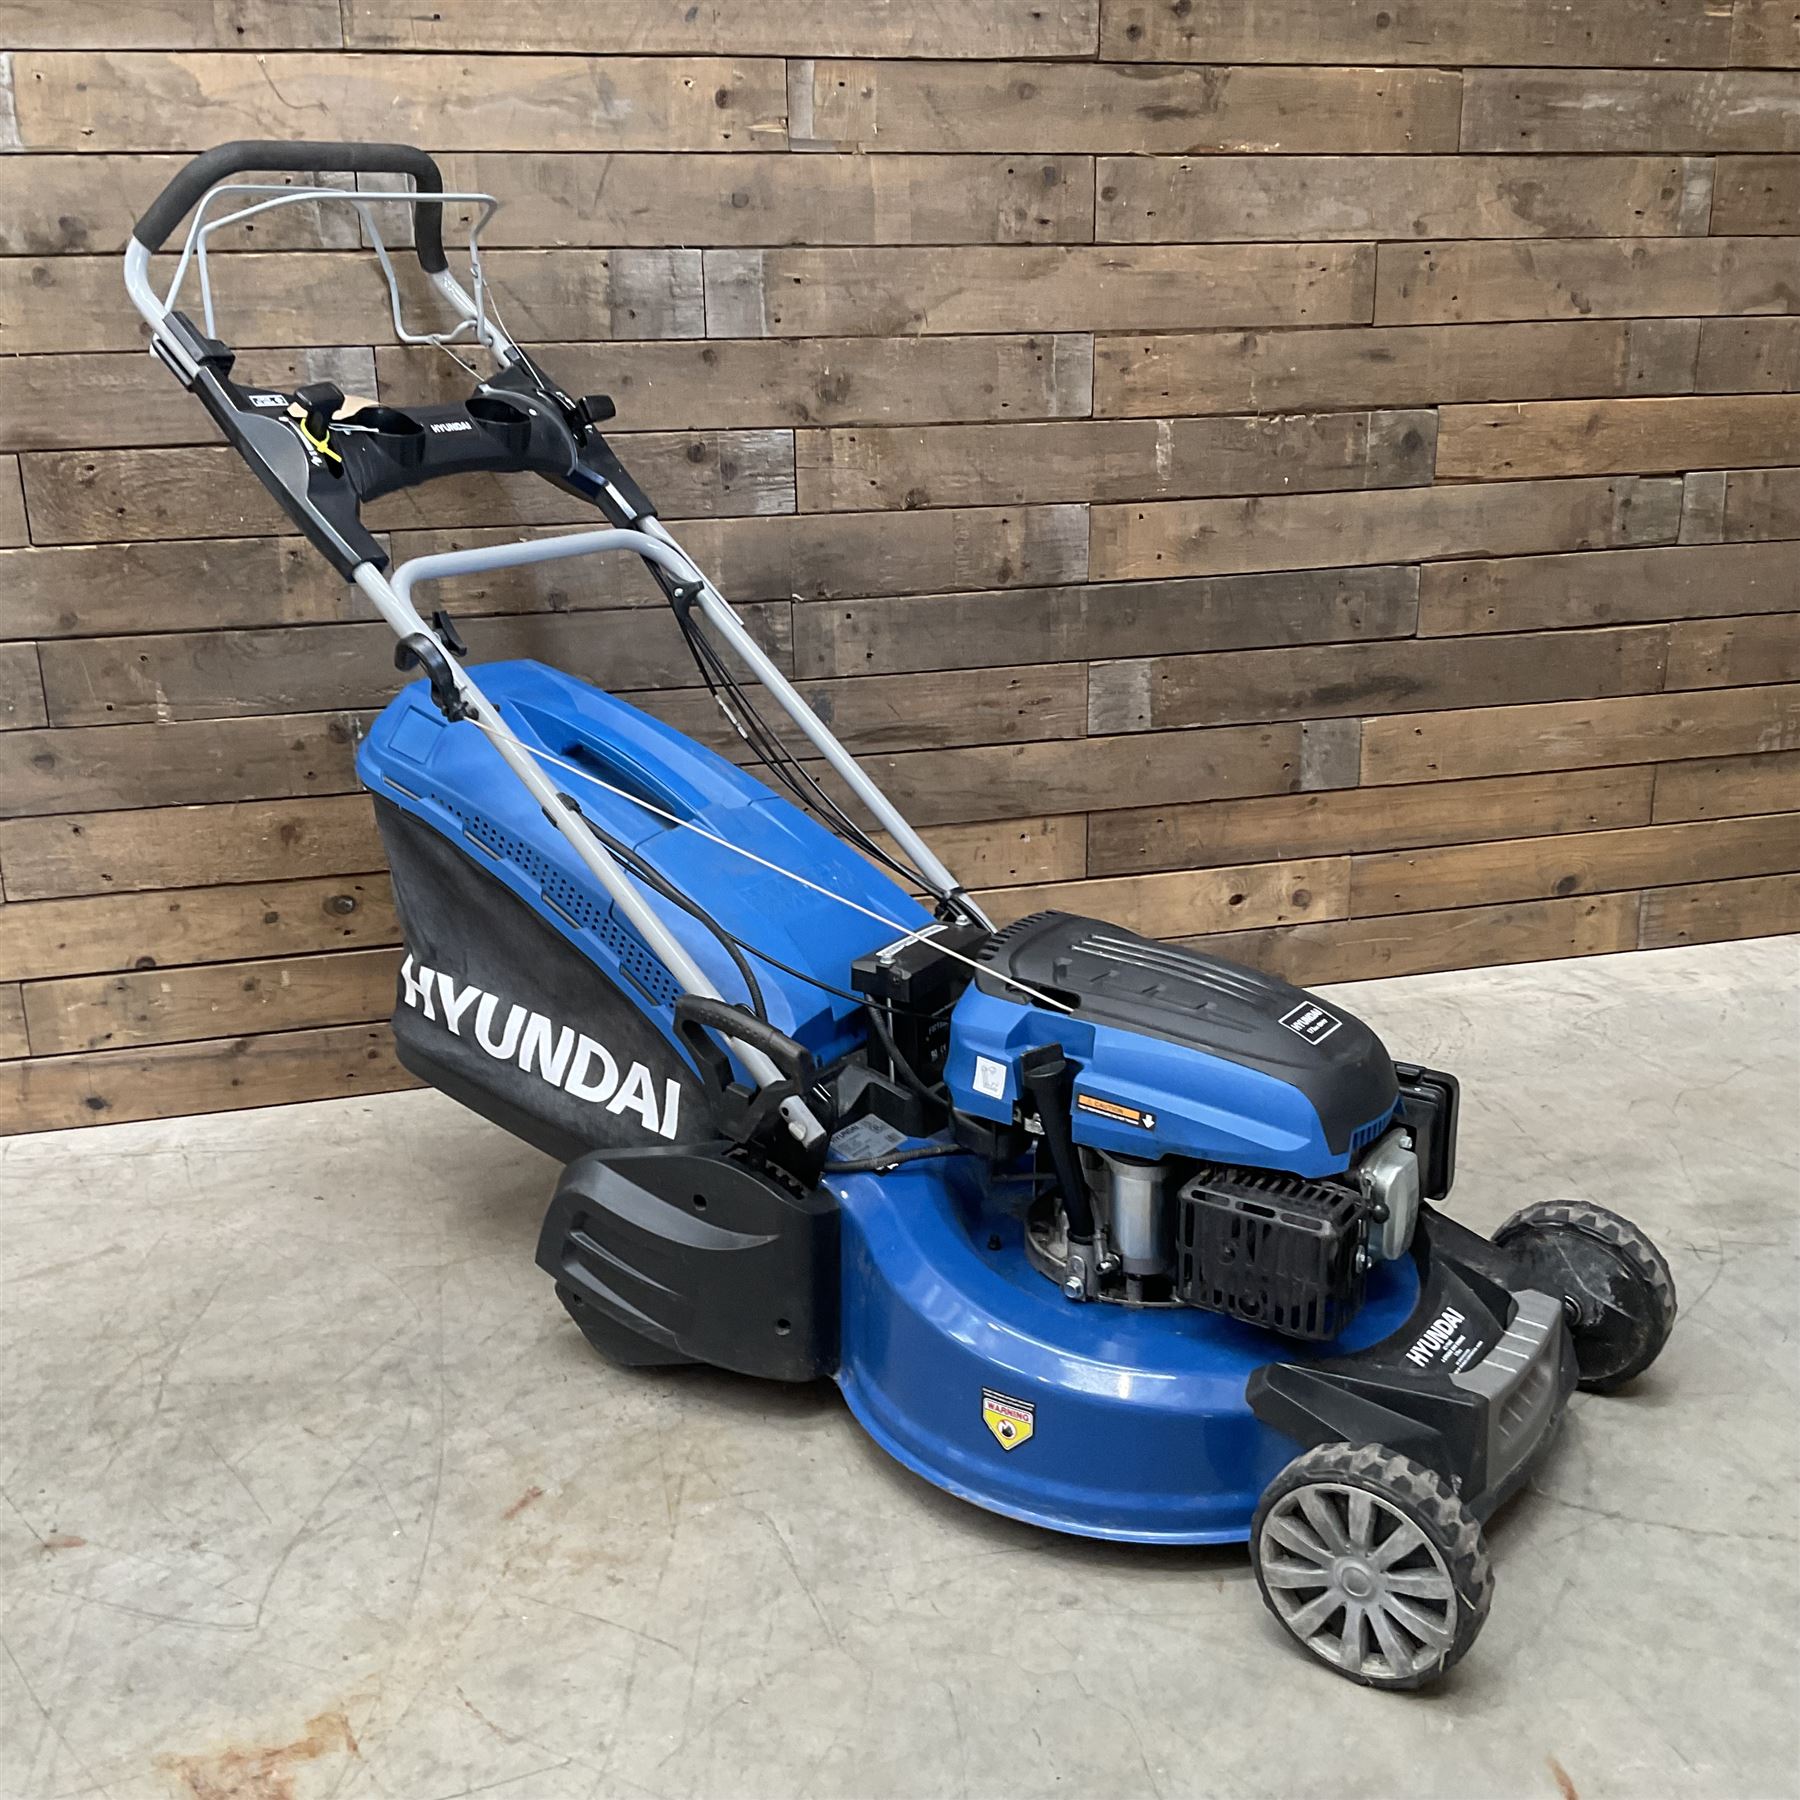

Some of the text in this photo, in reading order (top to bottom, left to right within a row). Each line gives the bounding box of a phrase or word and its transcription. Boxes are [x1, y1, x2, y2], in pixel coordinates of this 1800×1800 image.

[430, 421, 472, 434] HYUNDAI
[1290, 1007, 1323, 1032] HYUNDAI
[401, 953, 681, 1140] HYUNDAI
[1405, 1306, 1466, 1368] HYUNDAI
[987, 1401, 1029, 1422] WARNING
